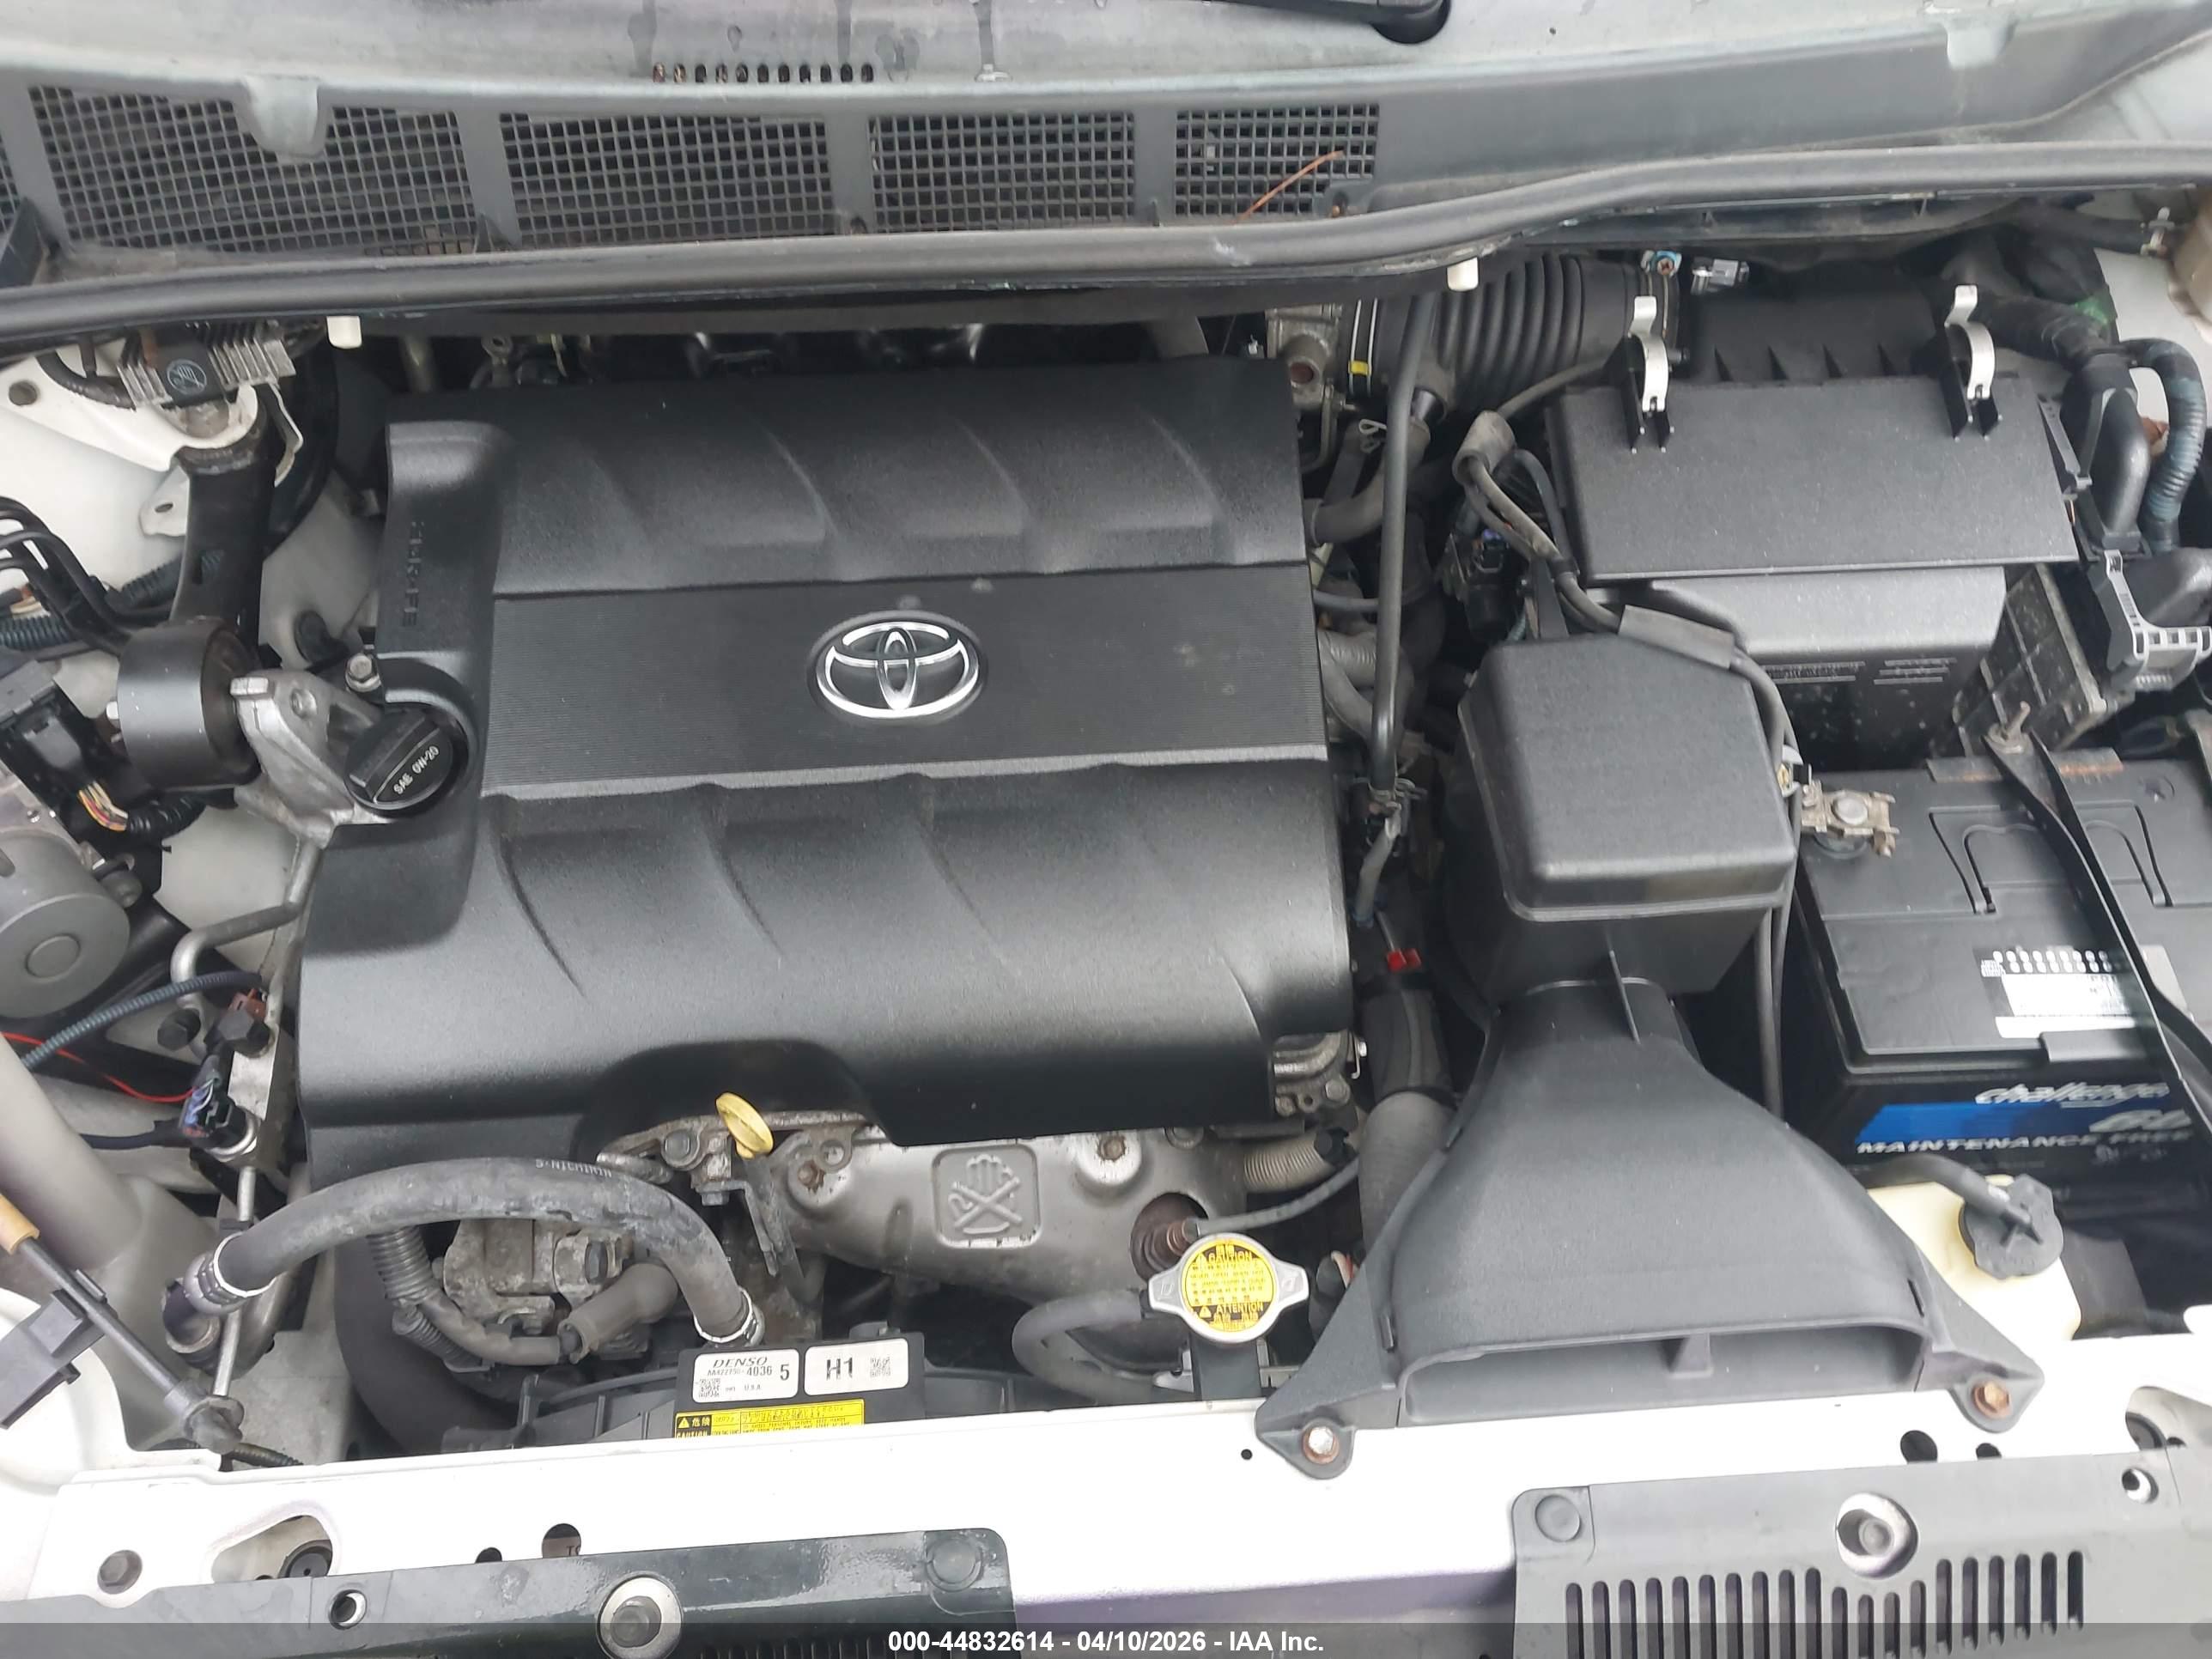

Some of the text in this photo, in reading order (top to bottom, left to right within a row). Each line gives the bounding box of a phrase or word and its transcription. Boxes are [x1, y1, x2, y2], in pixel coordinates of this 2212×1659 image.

[393, 745, 440, 794] SAE 0W-20
[1856, 1133, 2100, 1154] MAINTENANCE
[1216, 1303, 1264, 1314] ATTENTION
[713, 1357, 769, 1368] DENSO
[779, 1363, 791, 1382] 5
[826, 1357, 854, 1380] H1
